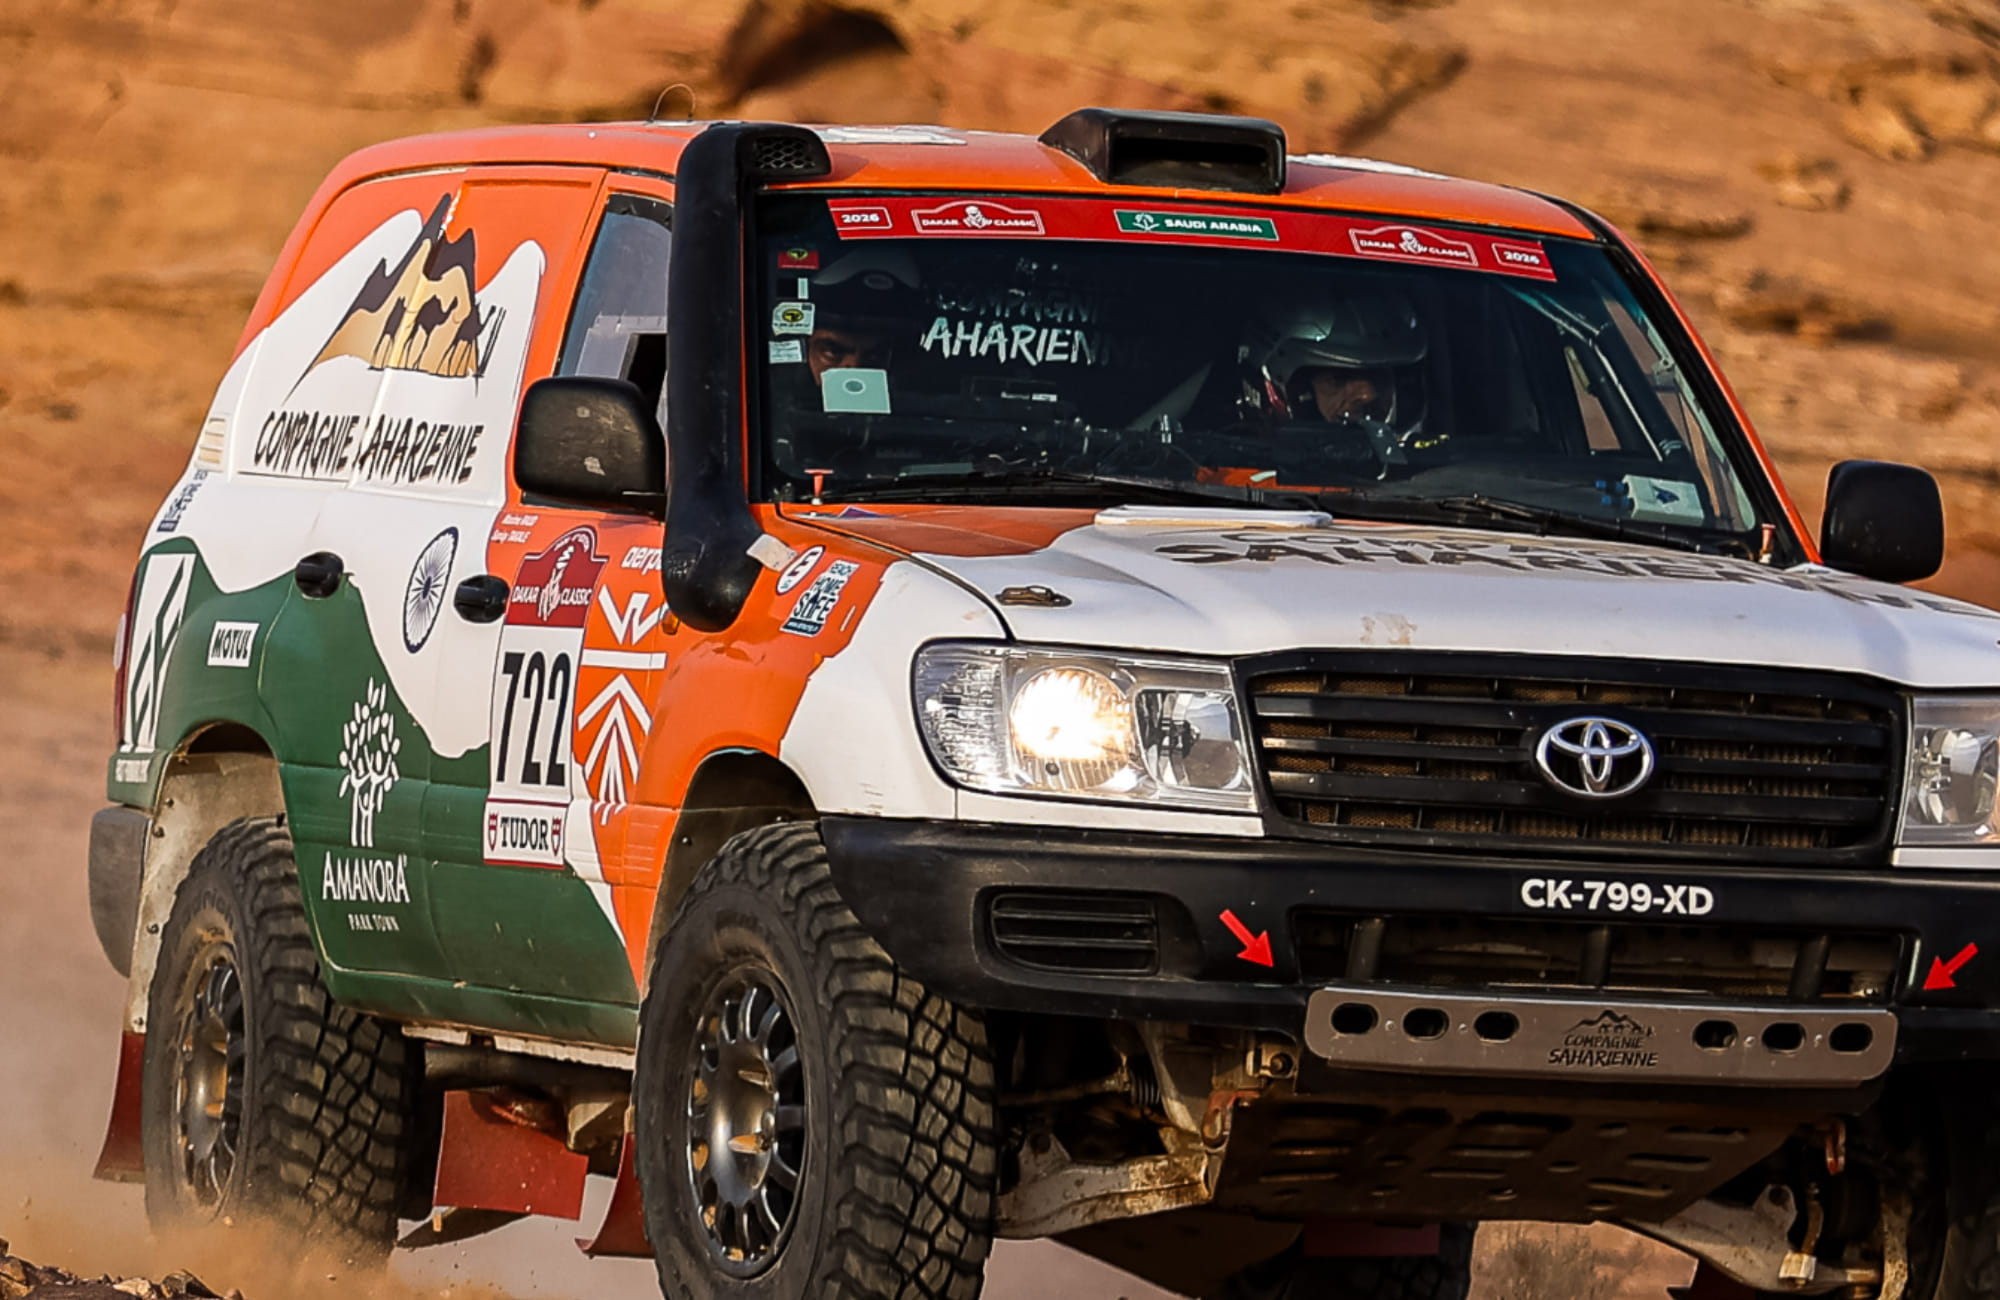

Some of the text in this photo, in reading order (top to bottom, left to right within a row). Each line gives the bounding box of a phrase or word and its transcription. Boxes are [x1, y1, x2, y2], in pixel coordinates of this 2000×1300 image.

[841, 214, 880, 223] 2026
[993, 219, 1037, 227] CLASSIC
[1164, 219, 1263, 233] SAUDI ARABIA
[1359, 239, 1470, 259] DAKAR CLASSIC
[1504, 251, 1541, 264] 2026
[253, 409, 359, 478] COMPAGNIE
[512, 586, 593, 605] DAKAR CLASSIC
[210, 629, 252, 659] MOTUL
[496, 651, 571, 786] 722
[501, 816, 549, 851] TUDOR
[322, 851, 410, 903] AMANORA
[1521, 878, 1714, 915] CK-799-XD
[1564, 1034, 1645, 1049] COMPAGNIE
[1548, 1048, 1659, 1067] SAHARIENNE
